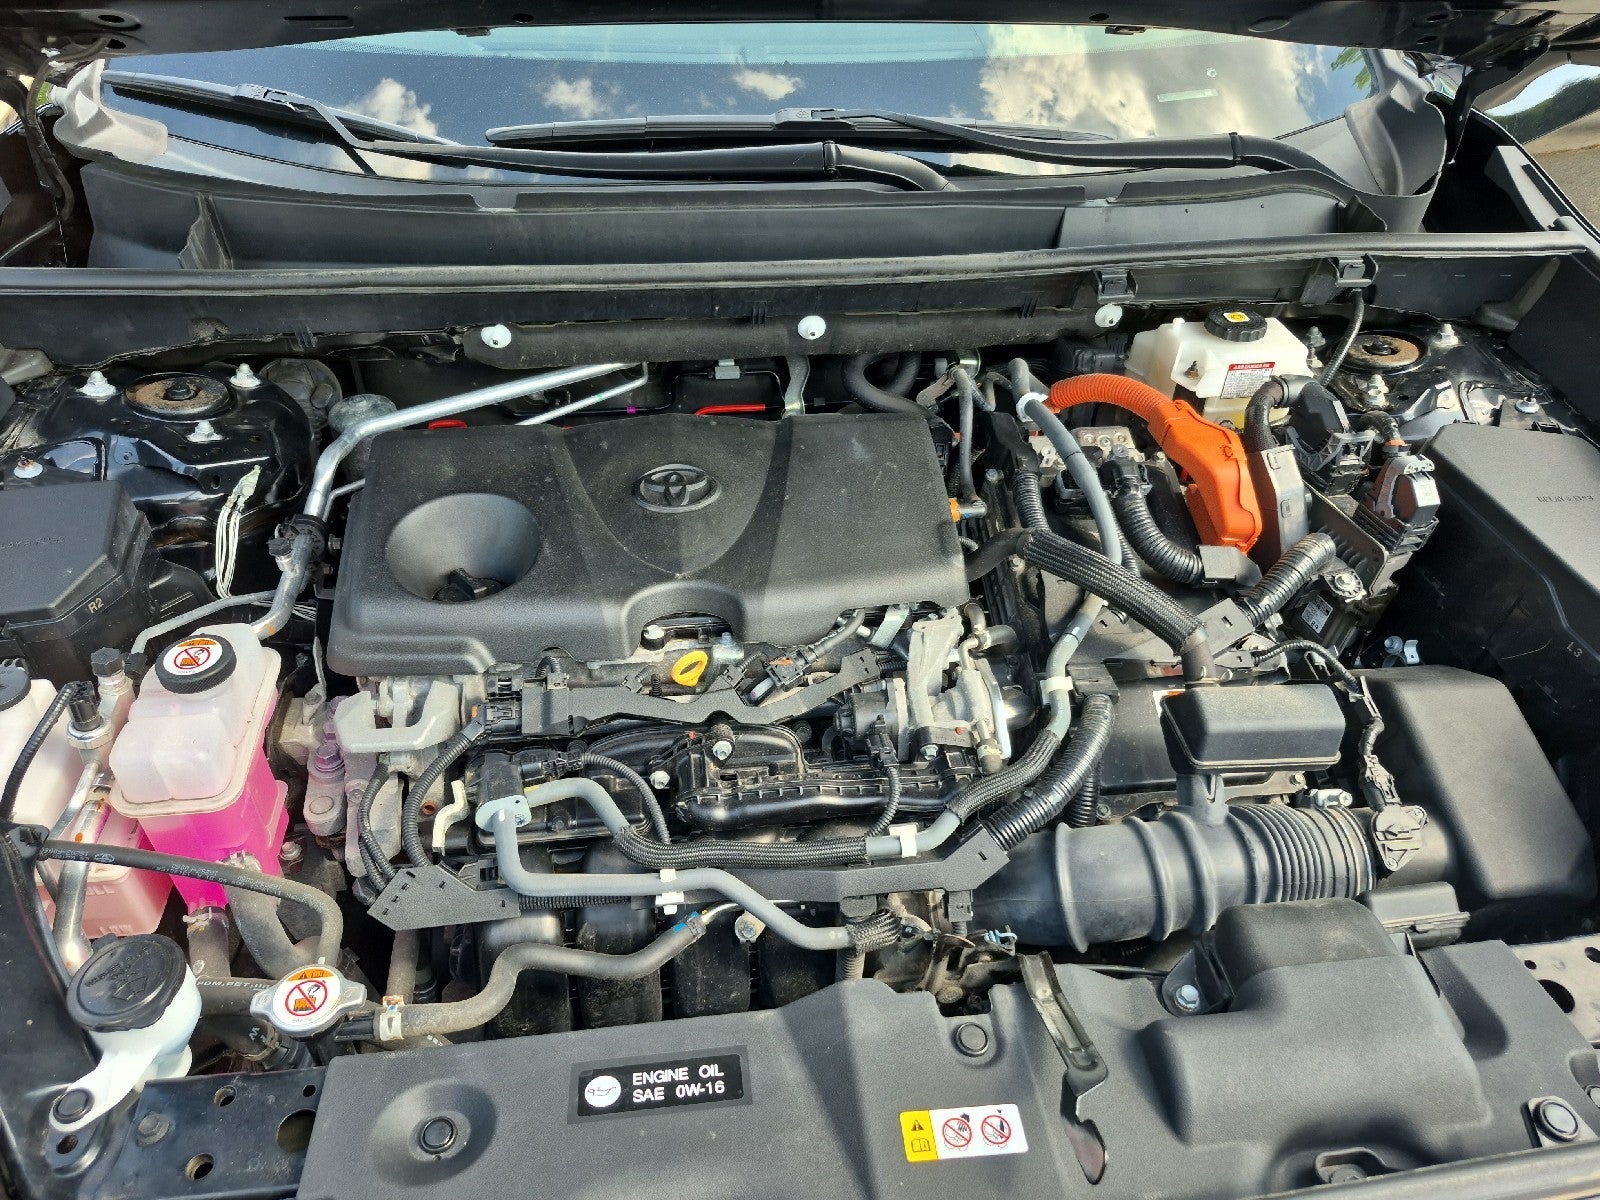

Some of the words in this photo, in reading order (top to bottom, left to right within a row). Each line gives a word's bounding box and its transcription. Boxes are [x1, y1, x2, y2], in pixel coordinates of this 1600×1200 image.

[87, 597, 105, 614] R2
[1566, 641, 1583, 658] L3
[632, 1067, 689, 1086] ENGINE
[698, 1063, 724, 1079] OIL
[632, 1086, 665, 1103] SAE
[675, 1080, 725, 1099] 0W-16
